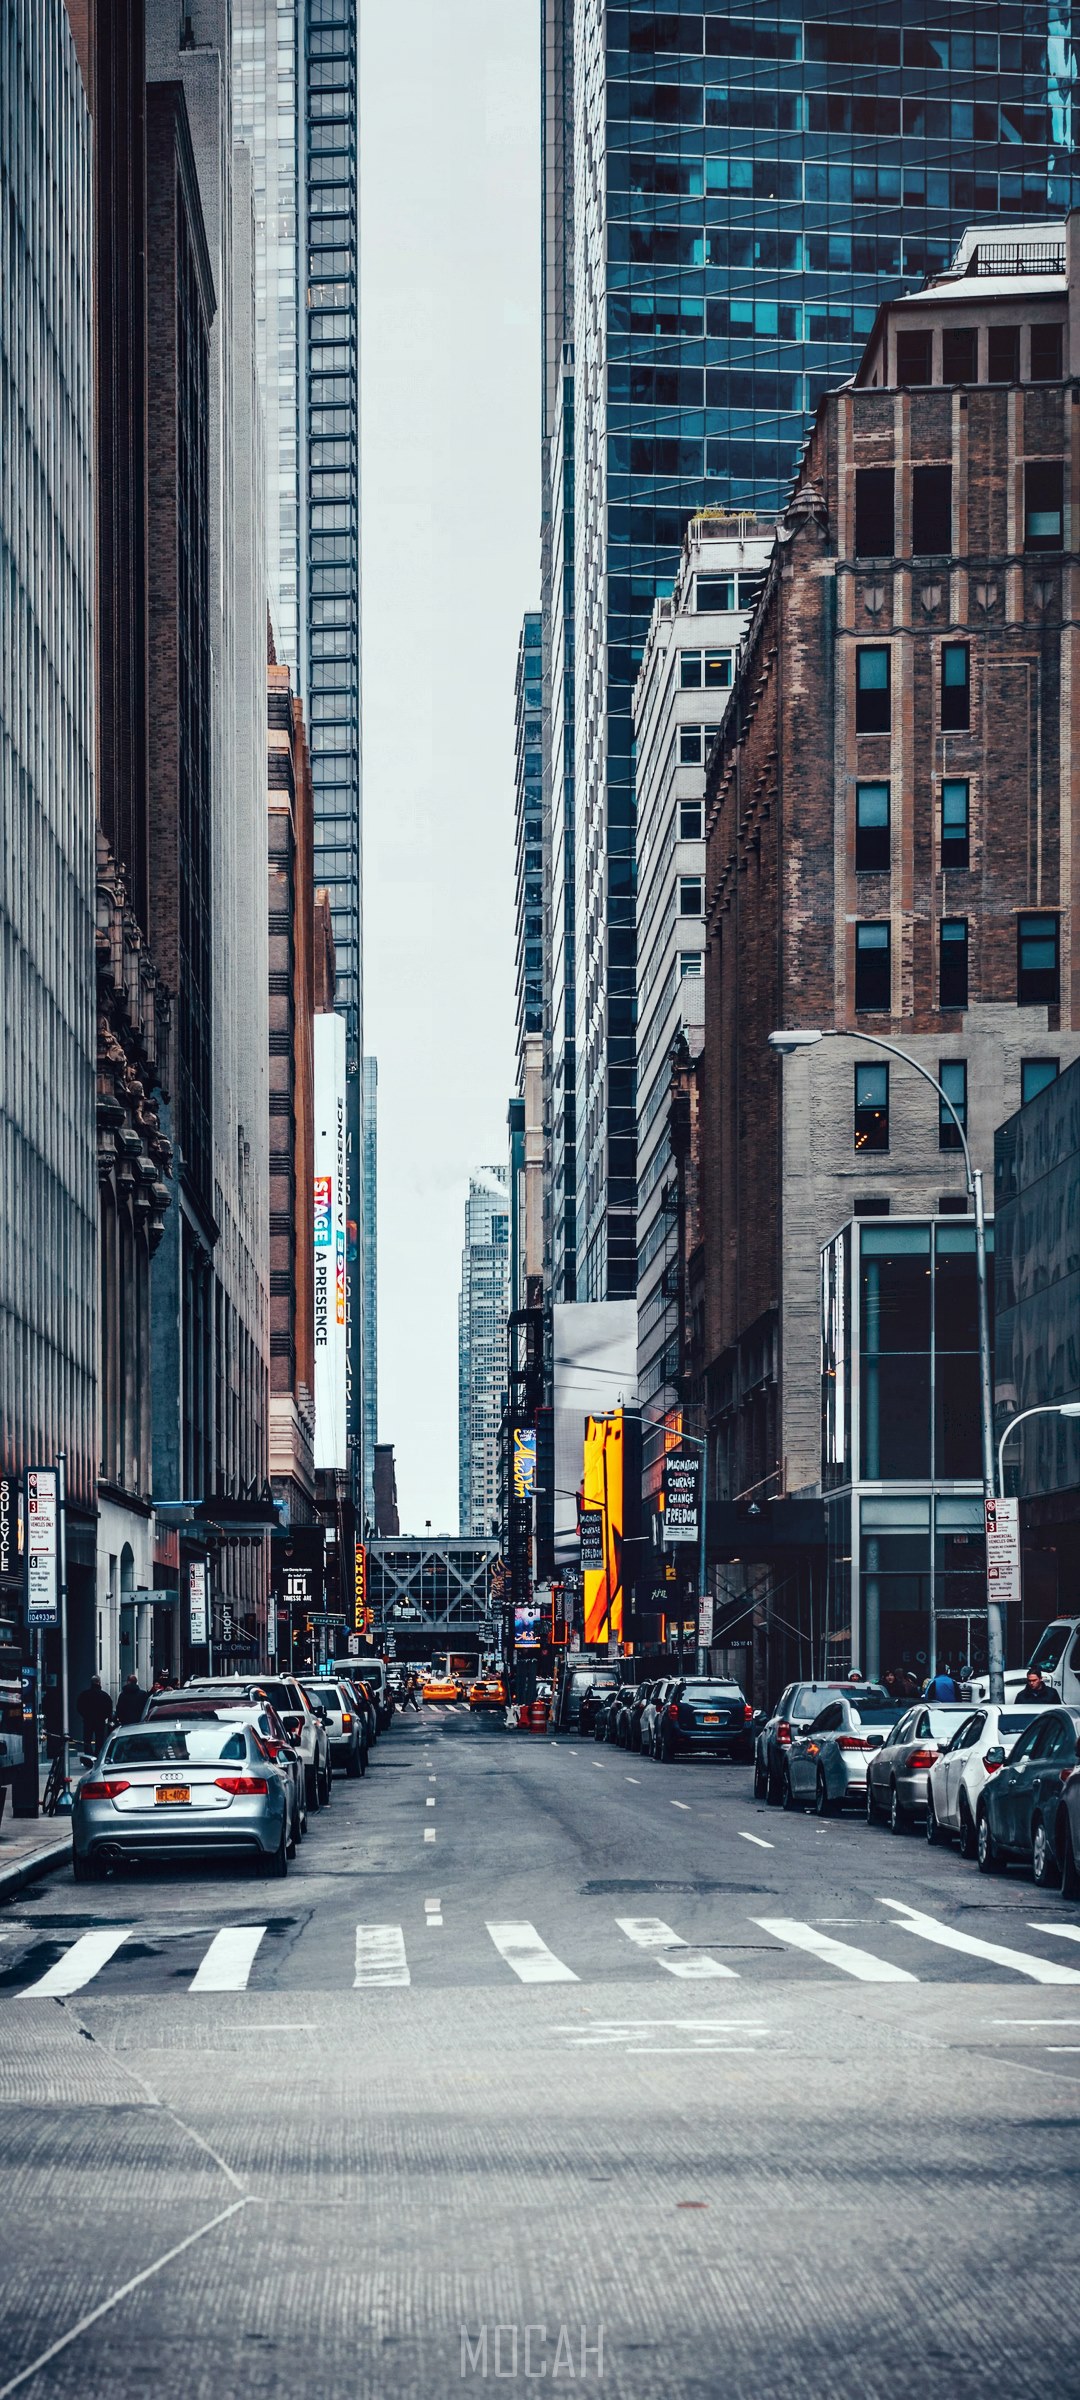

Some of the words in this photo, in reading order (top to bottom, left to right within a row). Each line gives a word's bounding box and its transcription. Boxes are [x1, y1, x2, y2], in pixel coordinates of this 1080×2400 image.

[315, 1180, 329, 1243] STAGE
[337, 1214, 344, 1227] A
[316, 1251, 327, 1263] A
[315, 1265, 328, 1347] PRESENCE
[666, 1458, 699, 1471] IMAGINATION
[668, 1477, 695, 1488] COURAGE
[668, 1493, 694, 1504] CHANGE
[31, 1501, 36, 1513] 3
[665, 1508, 697, 1525] FREEDOM
[0, 1481, 10, 1572] SOULCYCLE
[990, 1522, 995, 1532] 3
[223, 1604, 232, 1642] CHOPT
[902, 1650, 986, 1663] EQUINO
